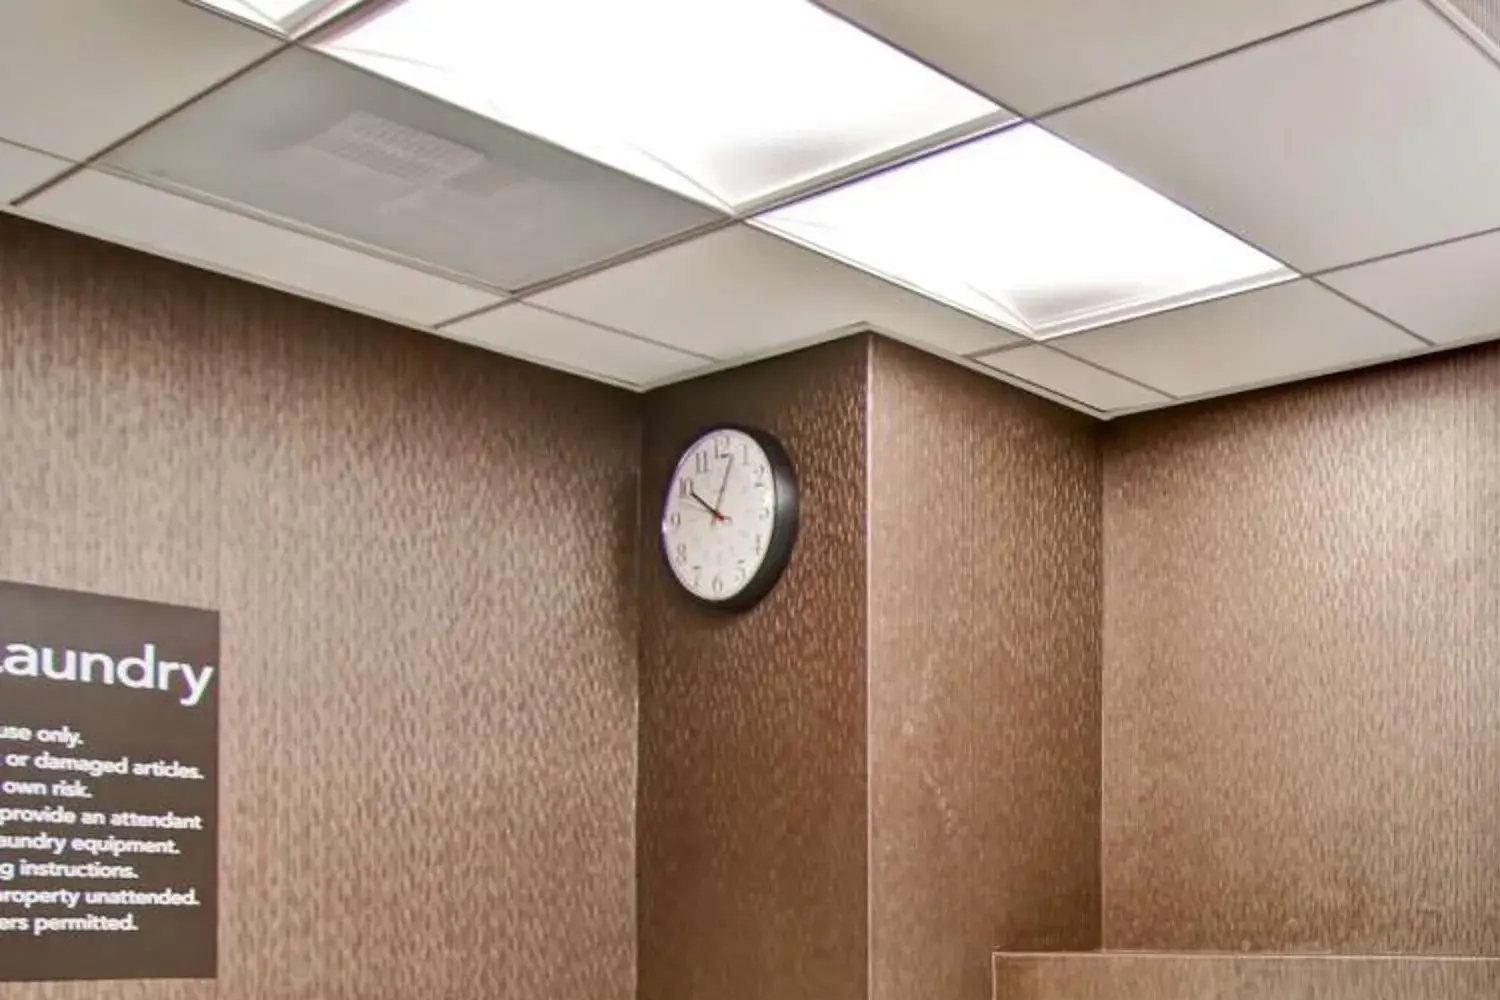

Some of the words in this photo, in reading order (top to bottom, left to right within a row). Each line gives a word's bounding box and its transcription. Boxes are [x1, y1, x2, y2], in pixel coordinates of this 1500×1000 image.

[713, 435, 730, 459] 12
[695, 451, 710, 474] 11
[679, 477, 693, 498] 10
[0, 642, 214, 706] aundry
[36, 725, 84, 749] only.
[5, 753, 30, 767] or
[34, 751, 128, 776] damaged
[132, 759, 204, 779] articles.
[2, 780, 47, 796] own
[51, 779, 93, 798] risk.
[0, 805, 76, 827] provide
[80, 811, 105, 825] an
[110, 811, 203, 830] attendant
[0, 832, 66, 855] aundry
[71, 835, 180, 857] equipment.
[19, 859, 139, 878] instructions.
[85, 887, 200, 905] unattended.
[33, 913, 139, 936] permitted.
